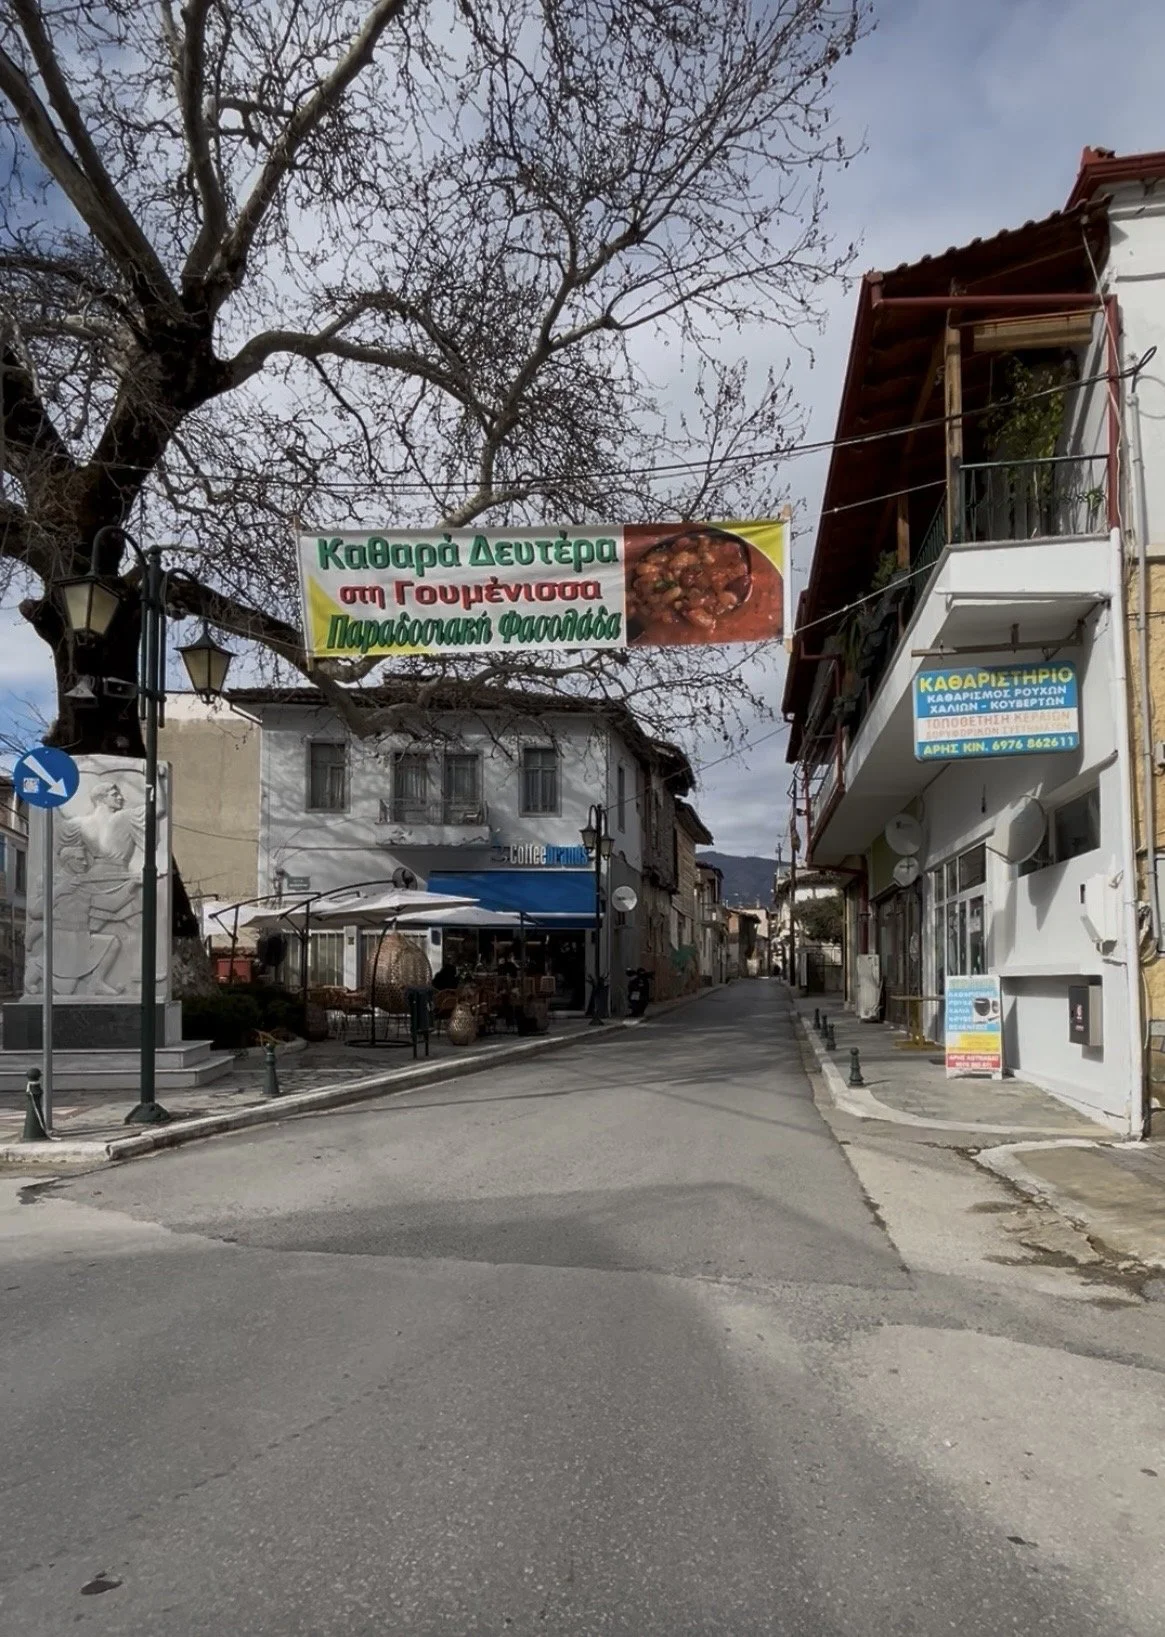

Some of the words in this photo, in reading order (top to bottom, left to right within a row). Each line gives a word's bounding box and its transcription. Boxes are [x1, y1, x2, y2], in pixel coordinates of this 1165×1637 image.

[317, 532, 462, 577] Καθαρά
[468, 529, 620, 573] Δευτέρα
[339, 583, 386, 610] στη
[395, 575, 603, 611] Γουμένισσα
[326, 610, 494, 654] Παραδοσιακή
[498, 605, 623, 645] Φασολάδα
[920, 667, 1074, 693] ΚΑΘΑΡΙΣΤΗΡΙΟ
[927, 689, 1011, 704] ΚΑΘΑΡΙΣΜΟΣ
[1014, 685, 1067, 698] ΡΟΥΧΩΝ
[930, 702, 978, 714] ΧΑΛΙΩΝ
[990, 697, 1065, 710] ΚΟΥΒΕΡΤΩΝ
[926, 714, 1011, 730] ΤΟΠΟΘΕΤΗΣΗ
[923, 743, 959, 755] ΑΡΗΣ
[963, 741, 988, 753] ΚΙΝ.
[992, 739, 1024, 751] 6976
[1026, 736, 1075, 749] 862611
